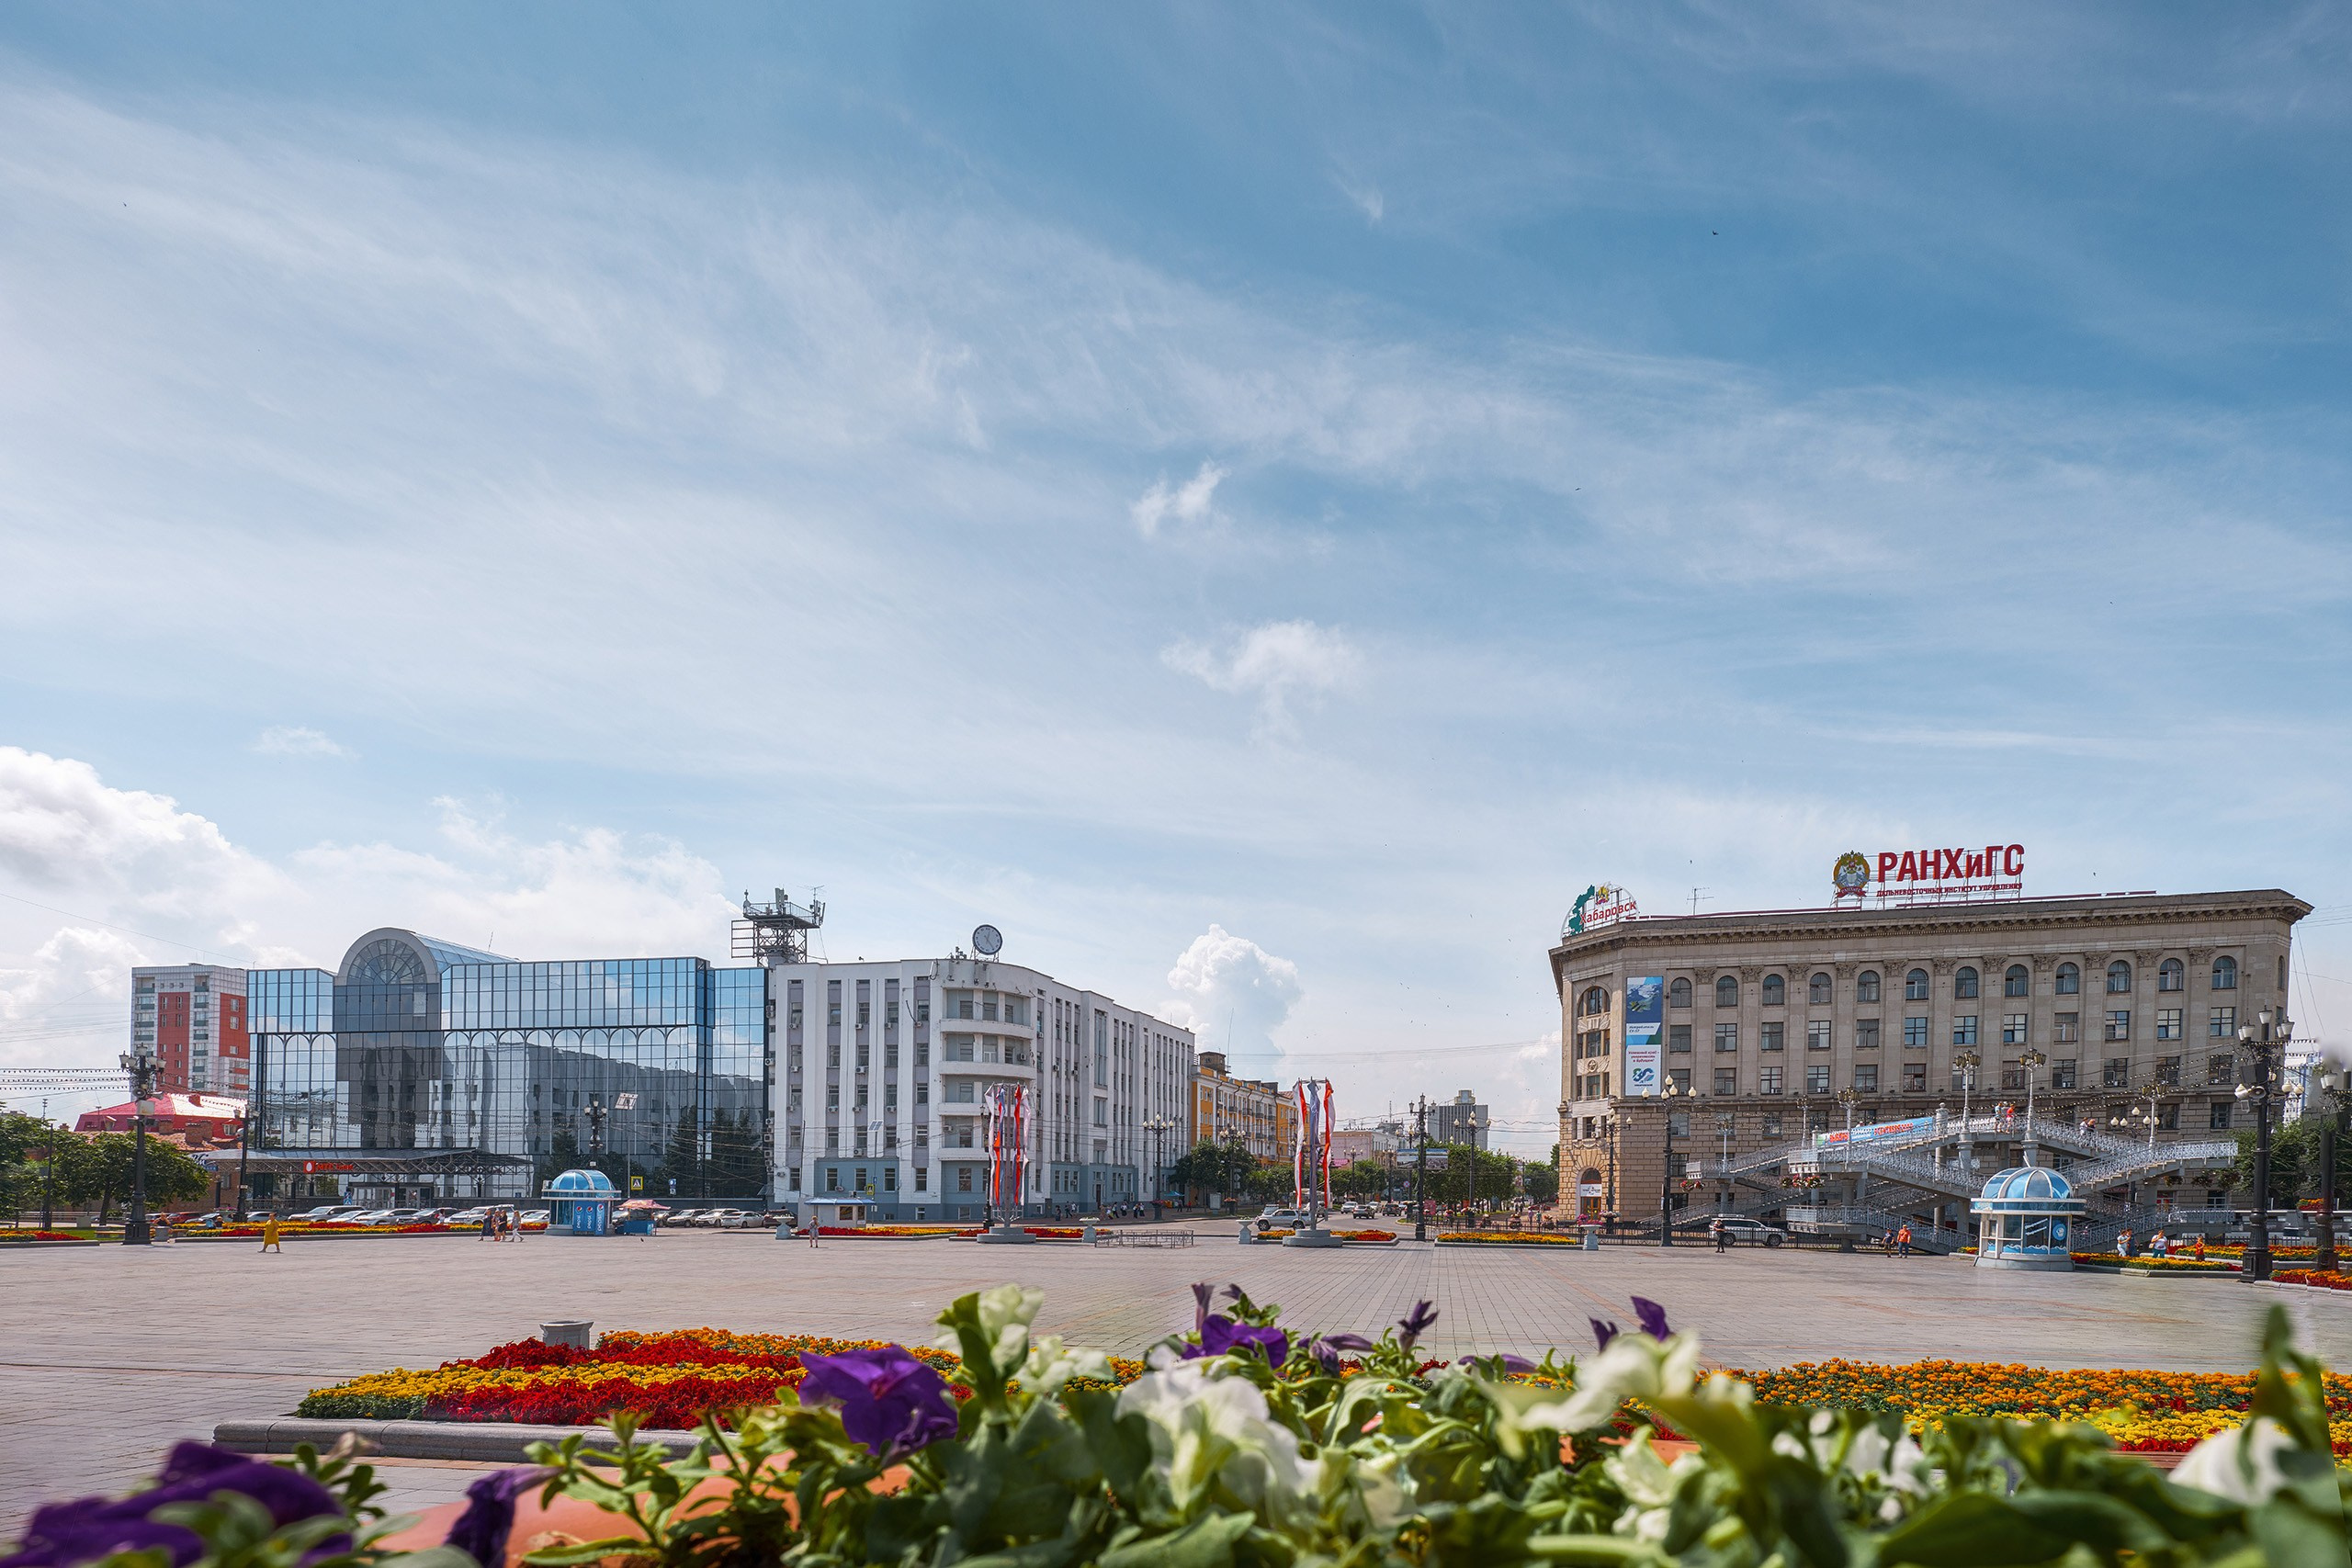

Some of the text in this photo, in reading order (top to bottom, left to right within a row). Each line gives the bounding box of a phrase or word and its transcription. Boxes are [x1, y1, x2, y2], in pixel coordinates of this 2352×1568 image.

[1877, 844, 2025, 883] РАНХиГС
[1876, 883, 2023, 897] ДАЛЬНЕВОСТОЧНЫЙ ИНСТИТУТ УПРАВЛЕНИЯ
[1579, 900, 1637, 925] Хабаровск
